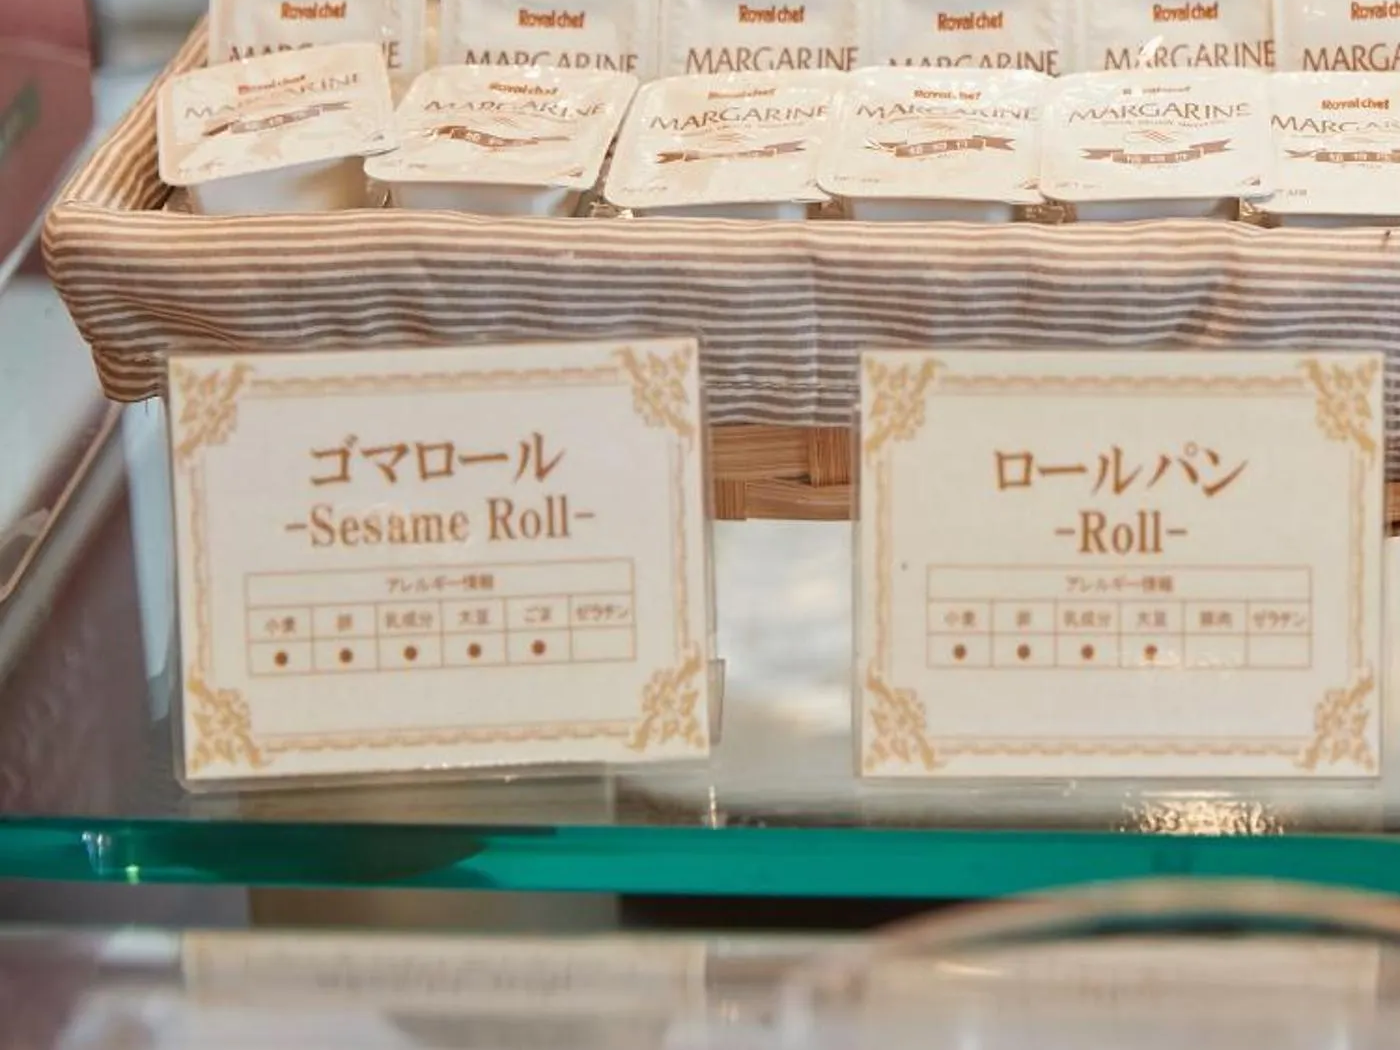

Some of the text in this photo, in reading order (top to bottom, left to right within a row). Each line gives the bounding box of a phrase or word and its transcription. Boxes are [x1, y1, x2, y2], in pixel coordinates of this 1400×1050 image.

[686, 46, 859, 74] MARGARINE
[650, 105, 829, 131] MARGARINE
[1069, 102, 1253, 125] MARGARINE
[309, 432, 566, 487] ゴマロール
[993, 441, 1249, 498] ロールパン
[385, 573, 494, 594] アレルギー情報
[1065, 575, 1174, 594] アレルギー情報
